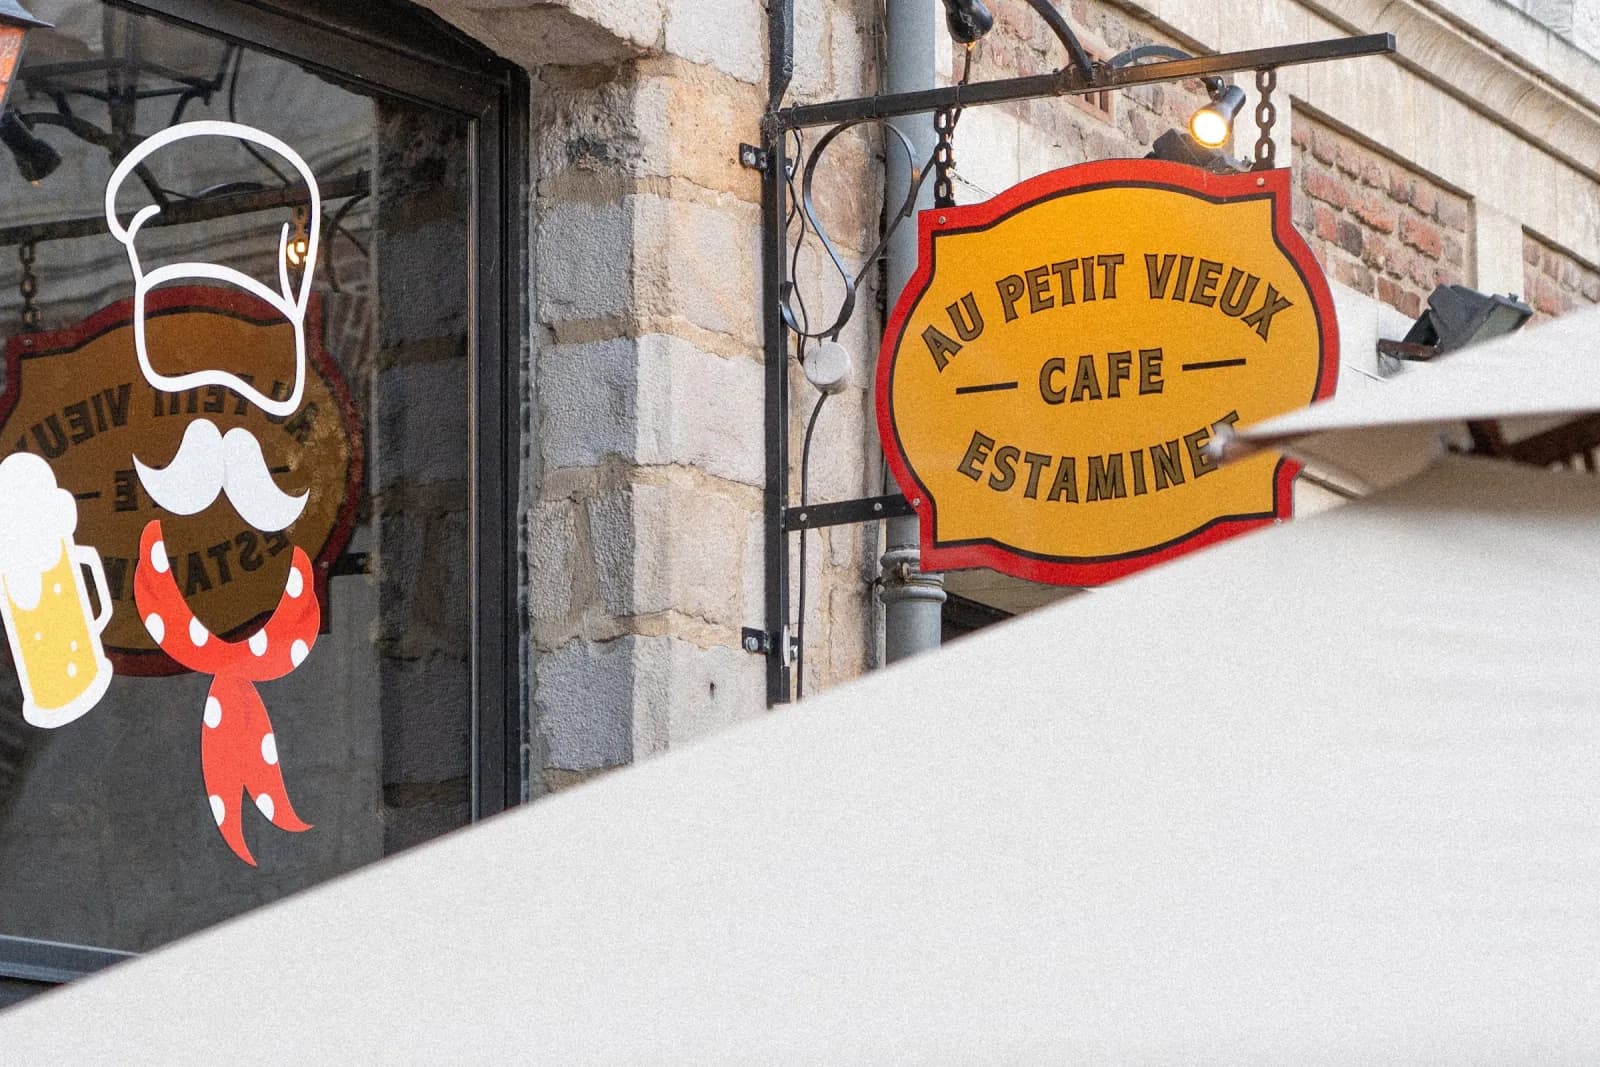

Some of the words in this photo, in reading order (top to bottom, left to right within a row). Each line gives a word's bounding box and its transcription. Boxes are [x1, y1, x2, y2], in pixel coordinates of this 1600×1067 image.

[921, 291, 985, 373] AU
[995, 253, 1125, 323] PETIT
[1143, 253, 1294, 343] VIEUX
[1038, 348, 1165, 405] CAFE
